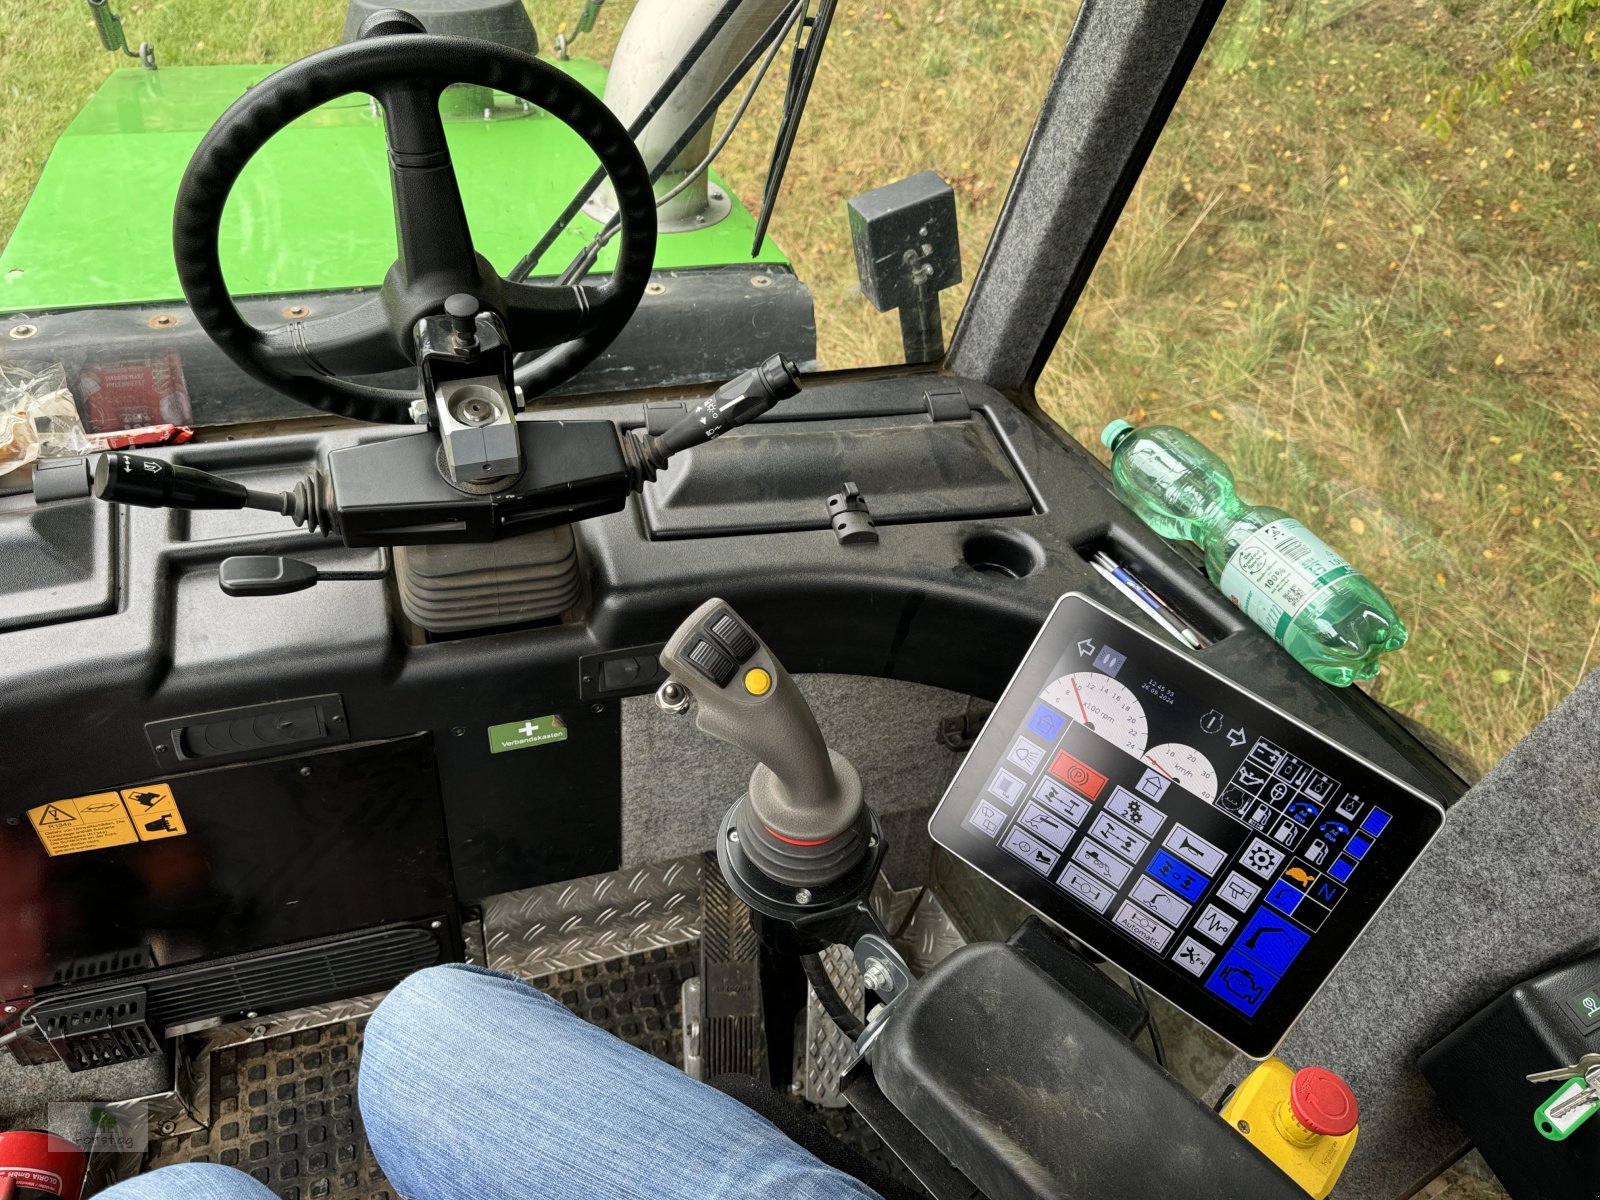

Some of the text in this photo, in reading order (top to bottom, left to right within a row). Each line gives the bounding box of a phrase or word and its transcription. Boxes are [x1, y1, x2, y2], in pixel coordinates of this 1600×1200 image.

[1264, 568, 1286, 588] 100%
[1100, 686, 1108, 694] 14
[1112, 693, 1121, 701] 16
[1083, 702, 1115, 724] x100 rpm
[1121, 703, 1130, 712] 18
[501, 731, 563, 747] Verbandskasten
[1166, 750, 1175, 758] 10
[1187, 754, 1197, 763] 20
[1175, 763, 1193, 778] km/h
[1201, 770, 1210, 779] 30
[1318, 883, 1336, 901] N
[1121, 918, 1160, 947] Automatic
[32, 1174, 57, 1185] GLORIA
